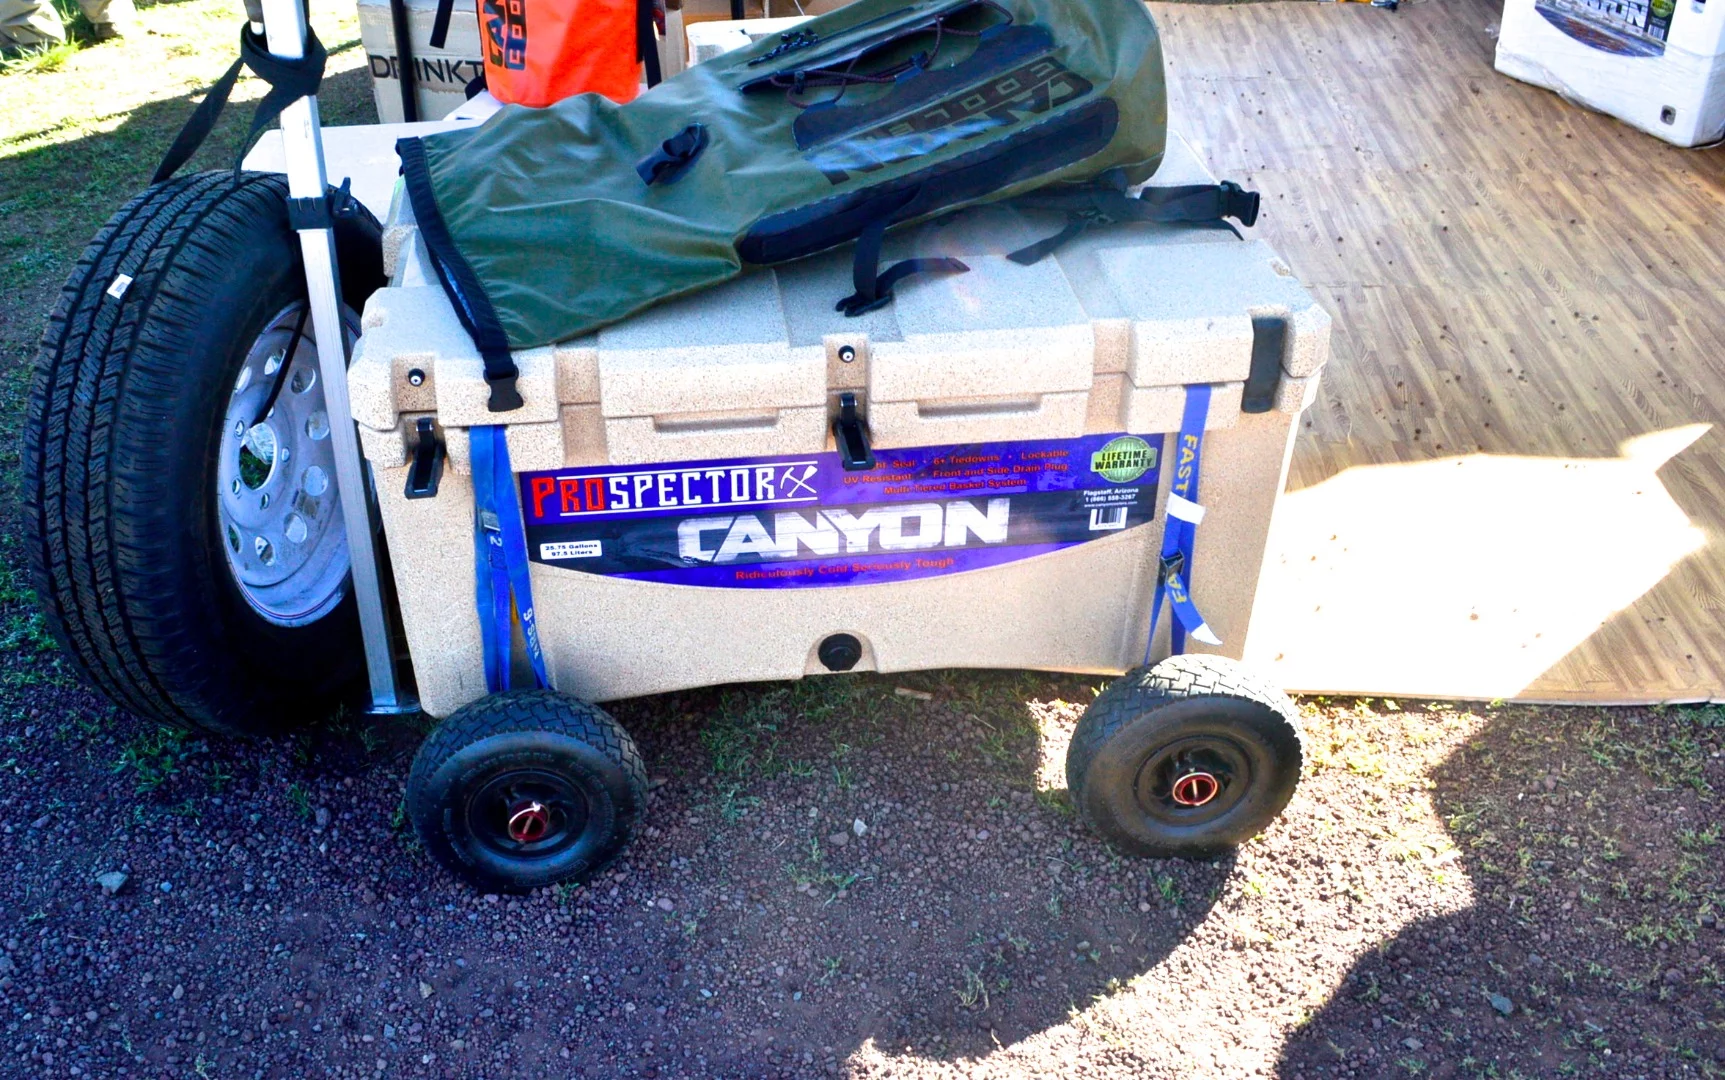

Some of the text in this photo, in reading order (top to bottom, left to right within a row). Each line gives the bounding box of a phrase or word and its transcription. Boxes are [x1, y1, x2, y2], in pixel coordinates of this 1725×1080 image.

[950, 455, 1000, 464] Tiedowns
[1021, 450, 1069, 460] Lockable
[1102, 450, 1147, 461] LIFETIME
[1095, 458, 1152, 470] WARRANTY
[933, 463, 1068, 478] Front and Side Drain Plug
[843, 474, 912, 484] UV Resistant
[949, 481, 984, 490] Basket
[987, 479, 1026, 488] System
[531, 466, 776, 517] PROSPECTOR
[677, 498, 1010, 562] CANYON
[736, 558, 955, 580] Ridiculously Cold Seriously Tough
